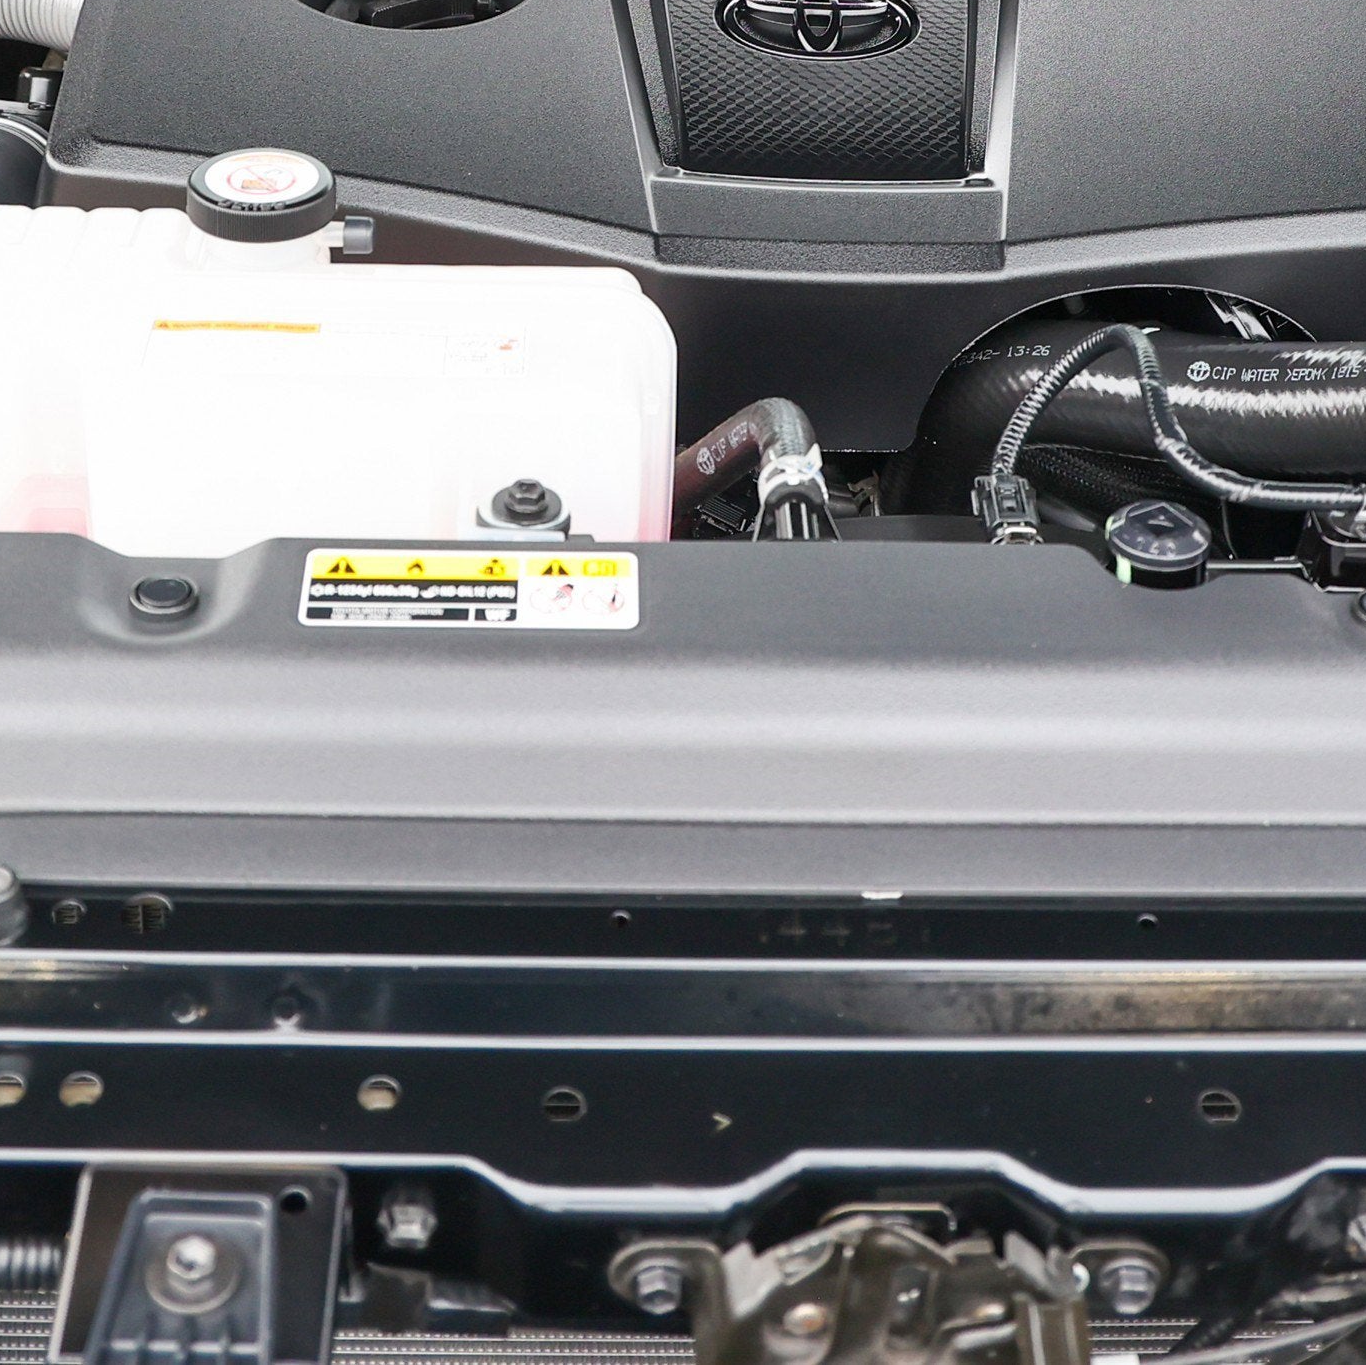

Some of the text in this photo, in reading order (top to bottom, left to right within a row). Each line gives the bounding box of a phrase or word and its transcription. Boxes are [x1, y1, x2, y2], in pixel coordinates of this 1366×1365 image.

[1006, 345, 1051, 357] 13:26
[1212, 366, 1236, 380] CIP
[1241, 368, 1280, 382] WATER
[1284, 368, 1327, 382] >EPDM<
